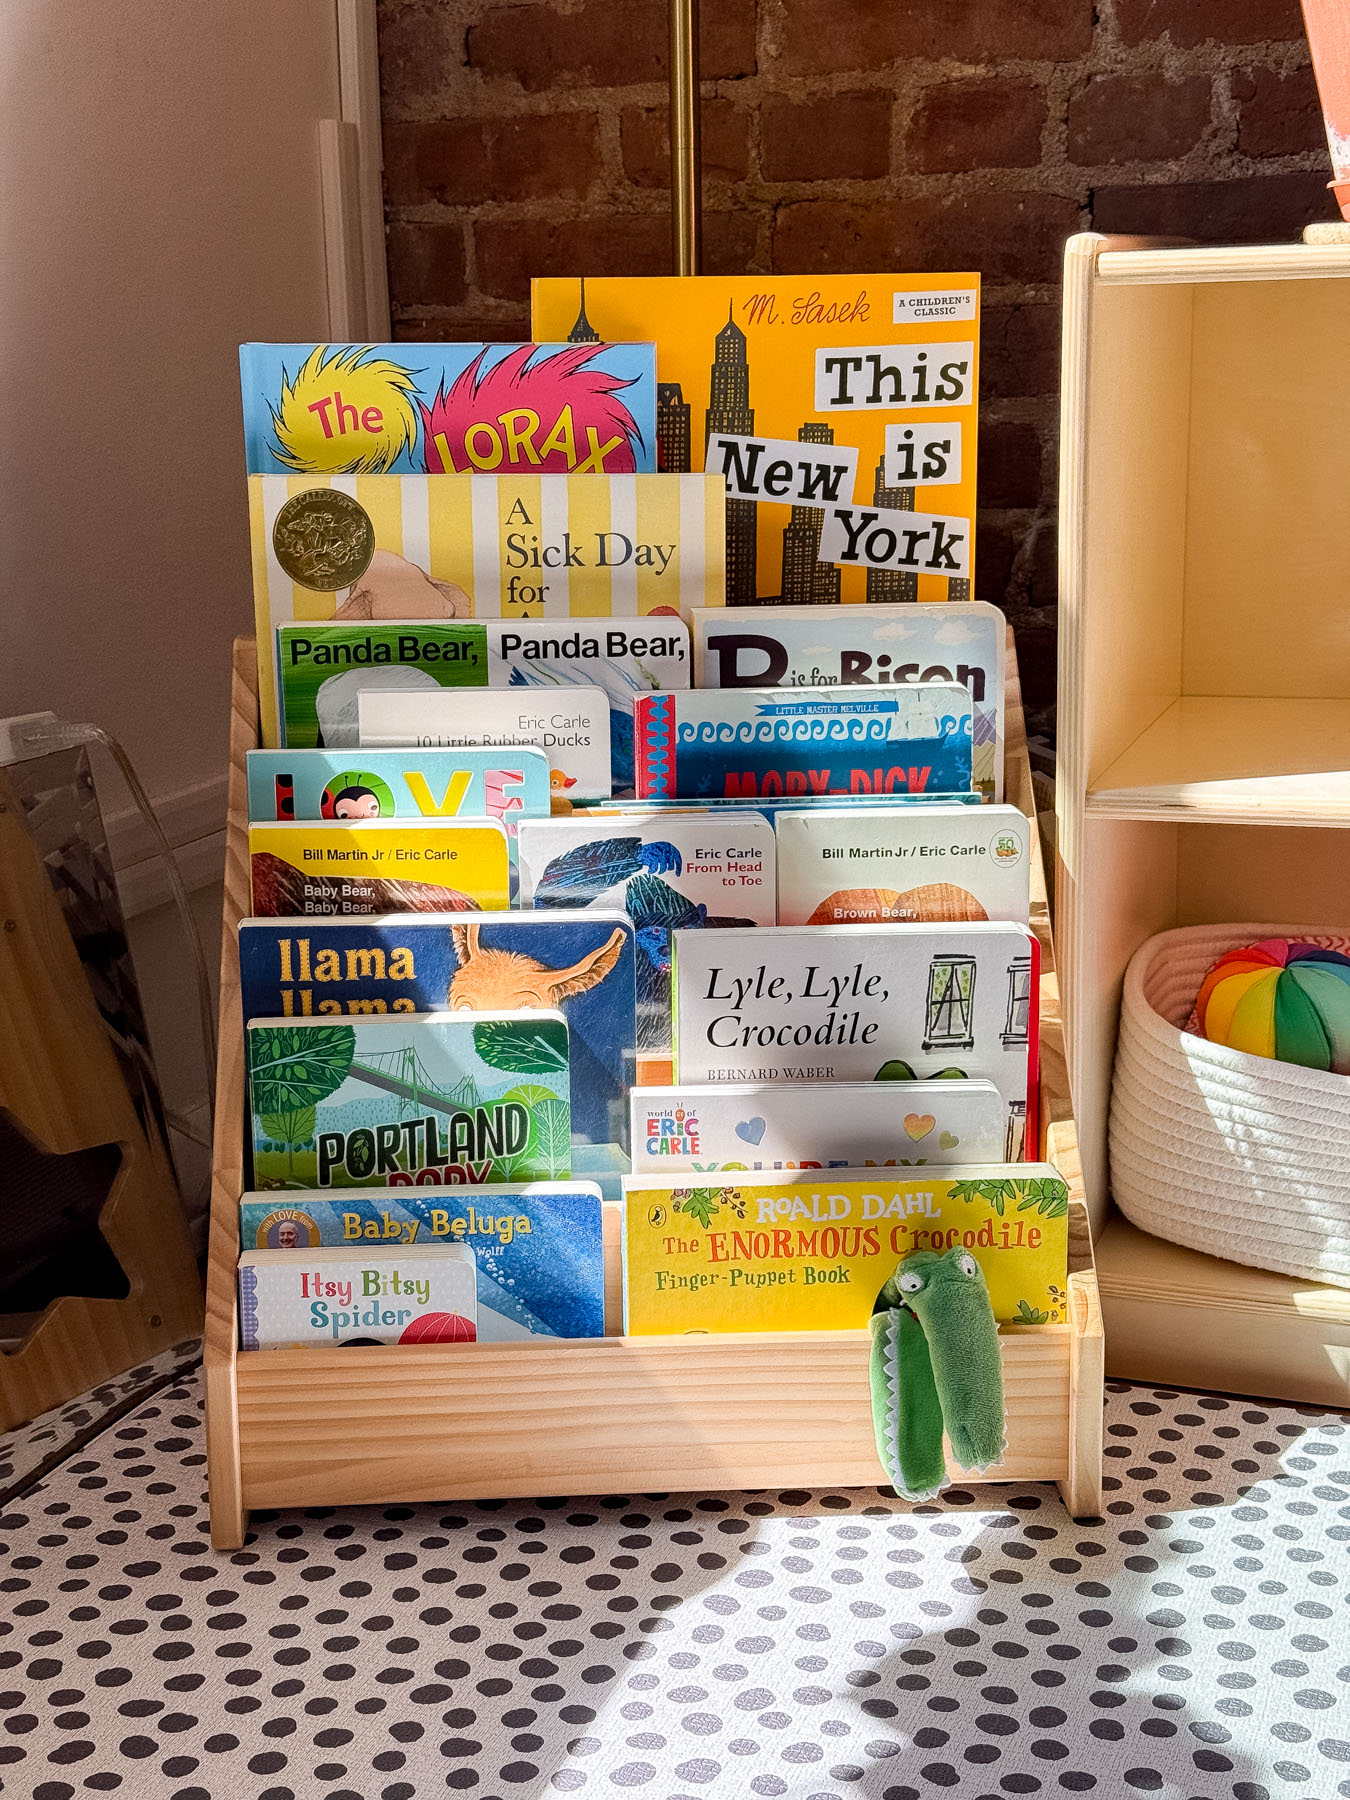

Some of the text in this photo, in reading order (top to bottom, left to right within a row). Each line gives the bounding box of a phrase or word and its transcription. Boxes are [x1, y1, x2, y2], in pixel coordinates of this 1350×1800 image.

[743, 290, 871, 326] M. Sasek
[898, 296, 971, 308] A CHILDREN'S
[913, 306, 957, 317] CLASSIC
[825, 353, 969, 406] This
[308, 391, 626, 473] The LORAX
[896, 430, 952, 481] is
[716, 440, 849, 502] New
[505, 497, 533, 525] A
[833, 509, 965, 570] York
[506, 532, 677, 576] Sick Day
[507, 575, 550, 604] for
[291, 631, 685, 666] Panda Bear, Panda Bear,
[810, 667, 838, 686] for
[519, 714, 591, 729] Eric Carle
[775, 704, 880, 715] LITTLE MASTER MELVILLE
[417, 733, 591, 747] 10 Little Rubber Ducks
[303, 849, 323, 860] Bill
[327, 849, 368, 860] Martin
[371, 849, 385, 860] Jr
[395, 849, 420, 860] Eric
[424, 849, 458, 860] Carle
[695, 848, 762, 859] Eric Carle
[822, 848, 844, 859] Bill
[849, 847, 893, 858] Martin
[895, 847, 908, 858] Jr
[920, 846, 946, 857] Eric
[950, 845, 986, 856] Carle
[687, 862, 762, 873] From Head
[722, 875, 763, 886] to Toe
[304, 884, 376, 899] Baby Bear,
[304, 901, 338, 915] Baby
[834, 907, 917, 919] Brown Bear,
[278, 938, 417, 982] llama
[703, 963, 890, 1011] Lyle, Lyle,
[707, 1011, 879, 1049] Crocodile
[707, 1066, 835, 1081] BERNARD WABER
[647, 1109, 697, 1118] world of
[317, 1102, 531, 1186] PORTLAND
[646, 1137, 700, 1155] CARLE
[756, 1192, 941, 1223] ROALD DAHL
[262, 1210, 313, 1233] with LOVE from
[343, 1207, 532, 1244] Baby Beluga
[476, 1246, 505, 1256] Wolff
[662, 1218, 1042, 1263] The ENORMOUS Crocodile
[300, 1270, 430, 1306] Itsy Bitsy
[656, 1265, 851, 1291] Finger-Puppet Book
[310, 1301, 412, 1339] Spider
